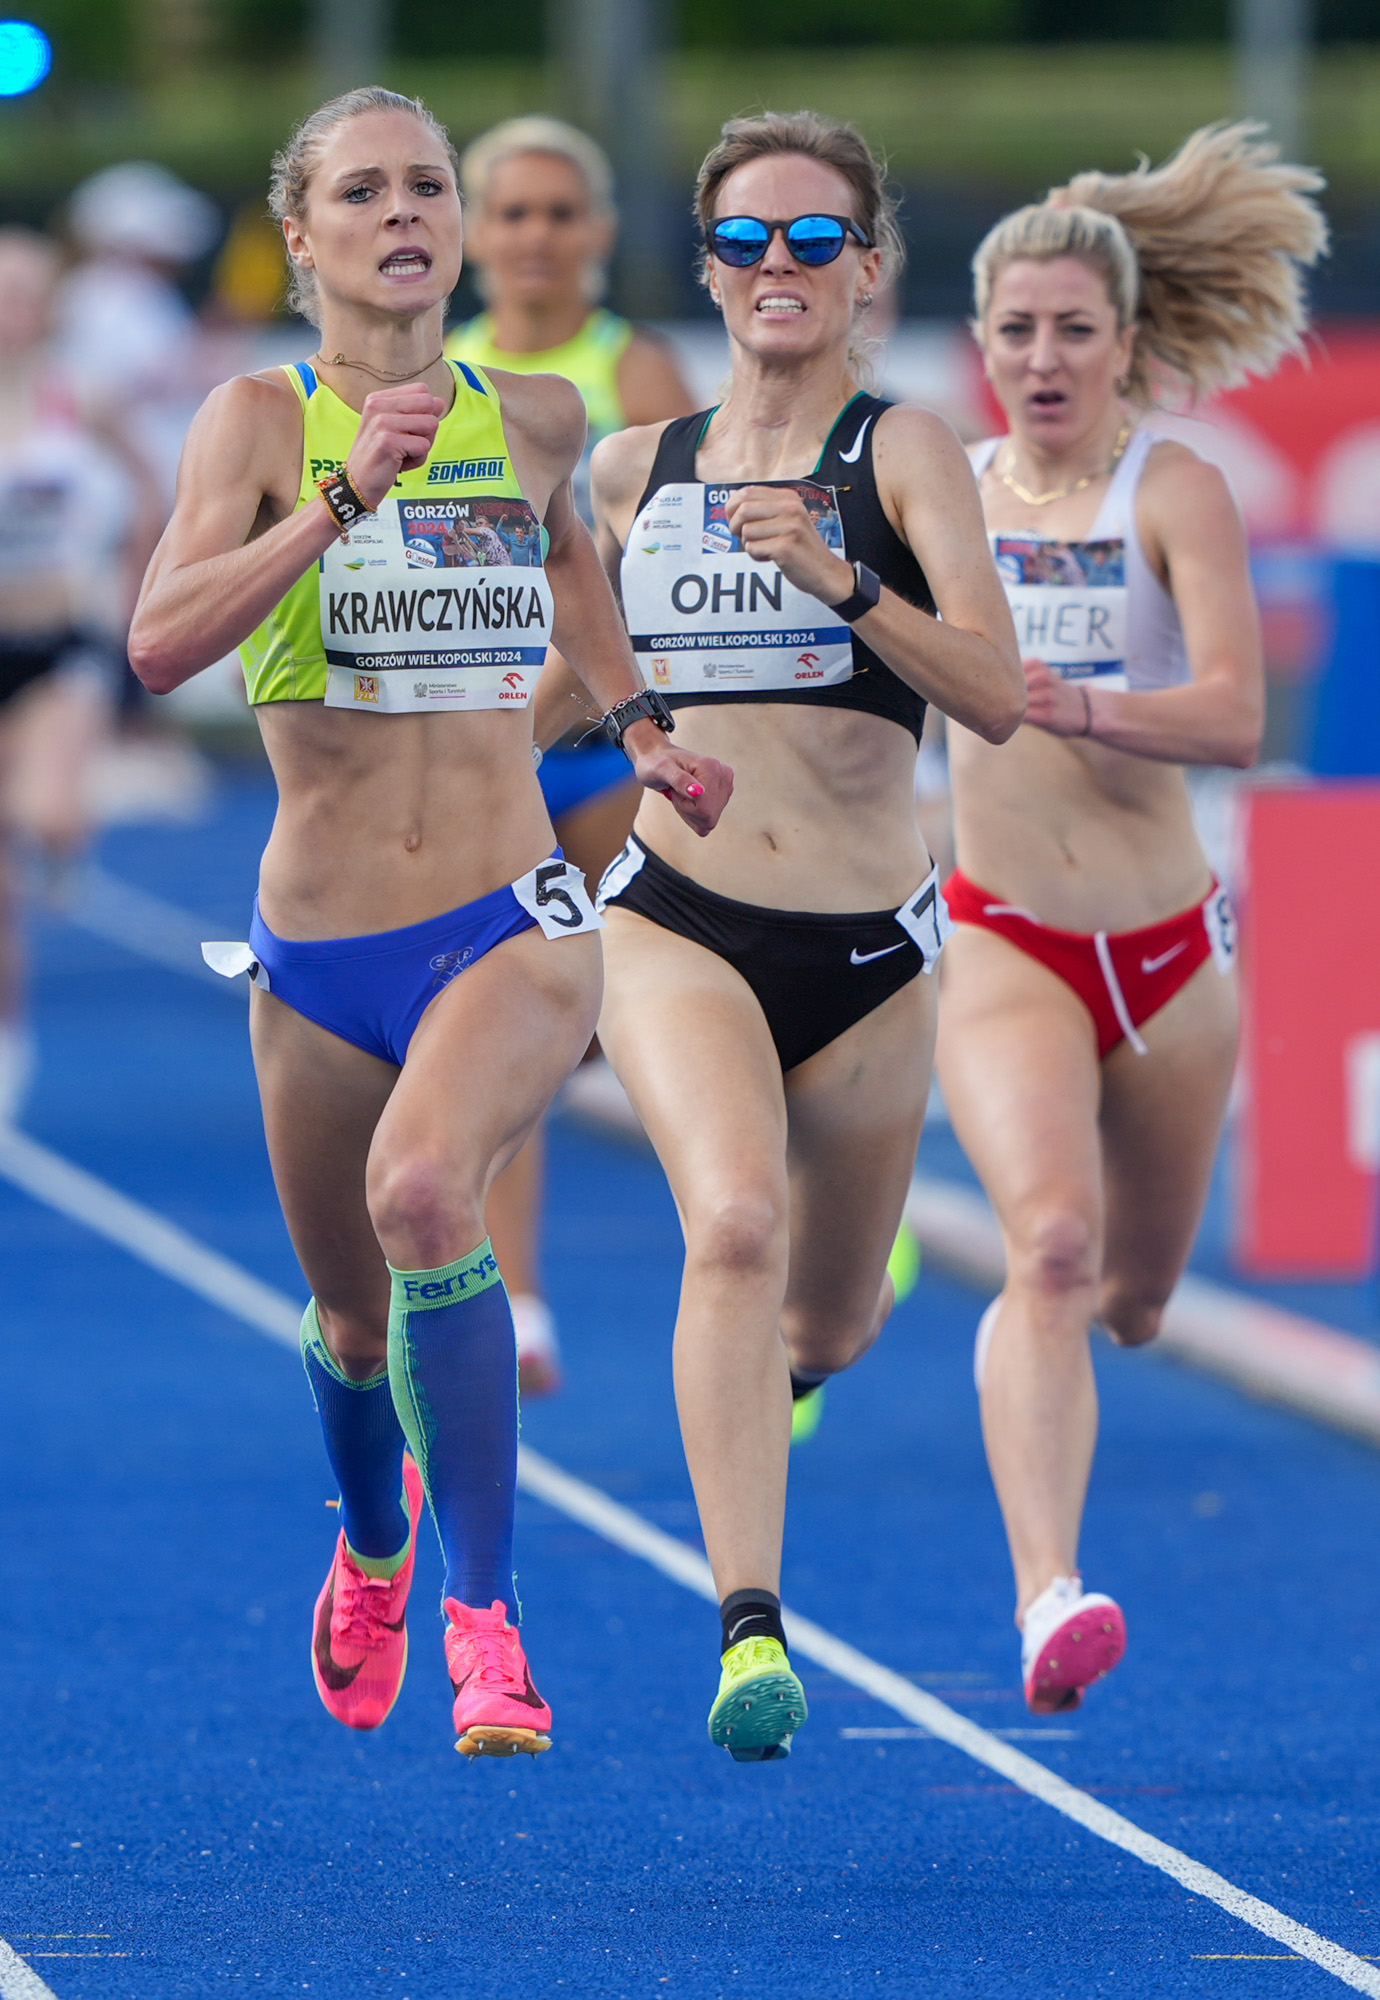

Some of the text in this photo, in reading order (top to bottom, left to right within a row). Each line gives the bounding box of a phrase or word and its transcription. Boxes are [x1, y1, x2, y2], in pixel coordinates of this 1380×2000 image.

[427, 459, 505, 484] SONAROL
[403, 501, 470, 519] GORZÓW
[407, 521, 446, 535] 2024
[671, 571, 783, 615] OHN
[329, 578, 545, 635] KRAWCZYŃSKA
[650, 632, 816, 649] GORZÓW WIELKOPOLSKI 2024
[355, 651, 522, 668] GORZÓW WIELKOPOLSKI 2024
[794, 671, 824, 680] ORLEN
[498, 692, 527, 700] ORLEN
[535, 862, 583, 927] 5
[911, 881, 942, 948] 7
